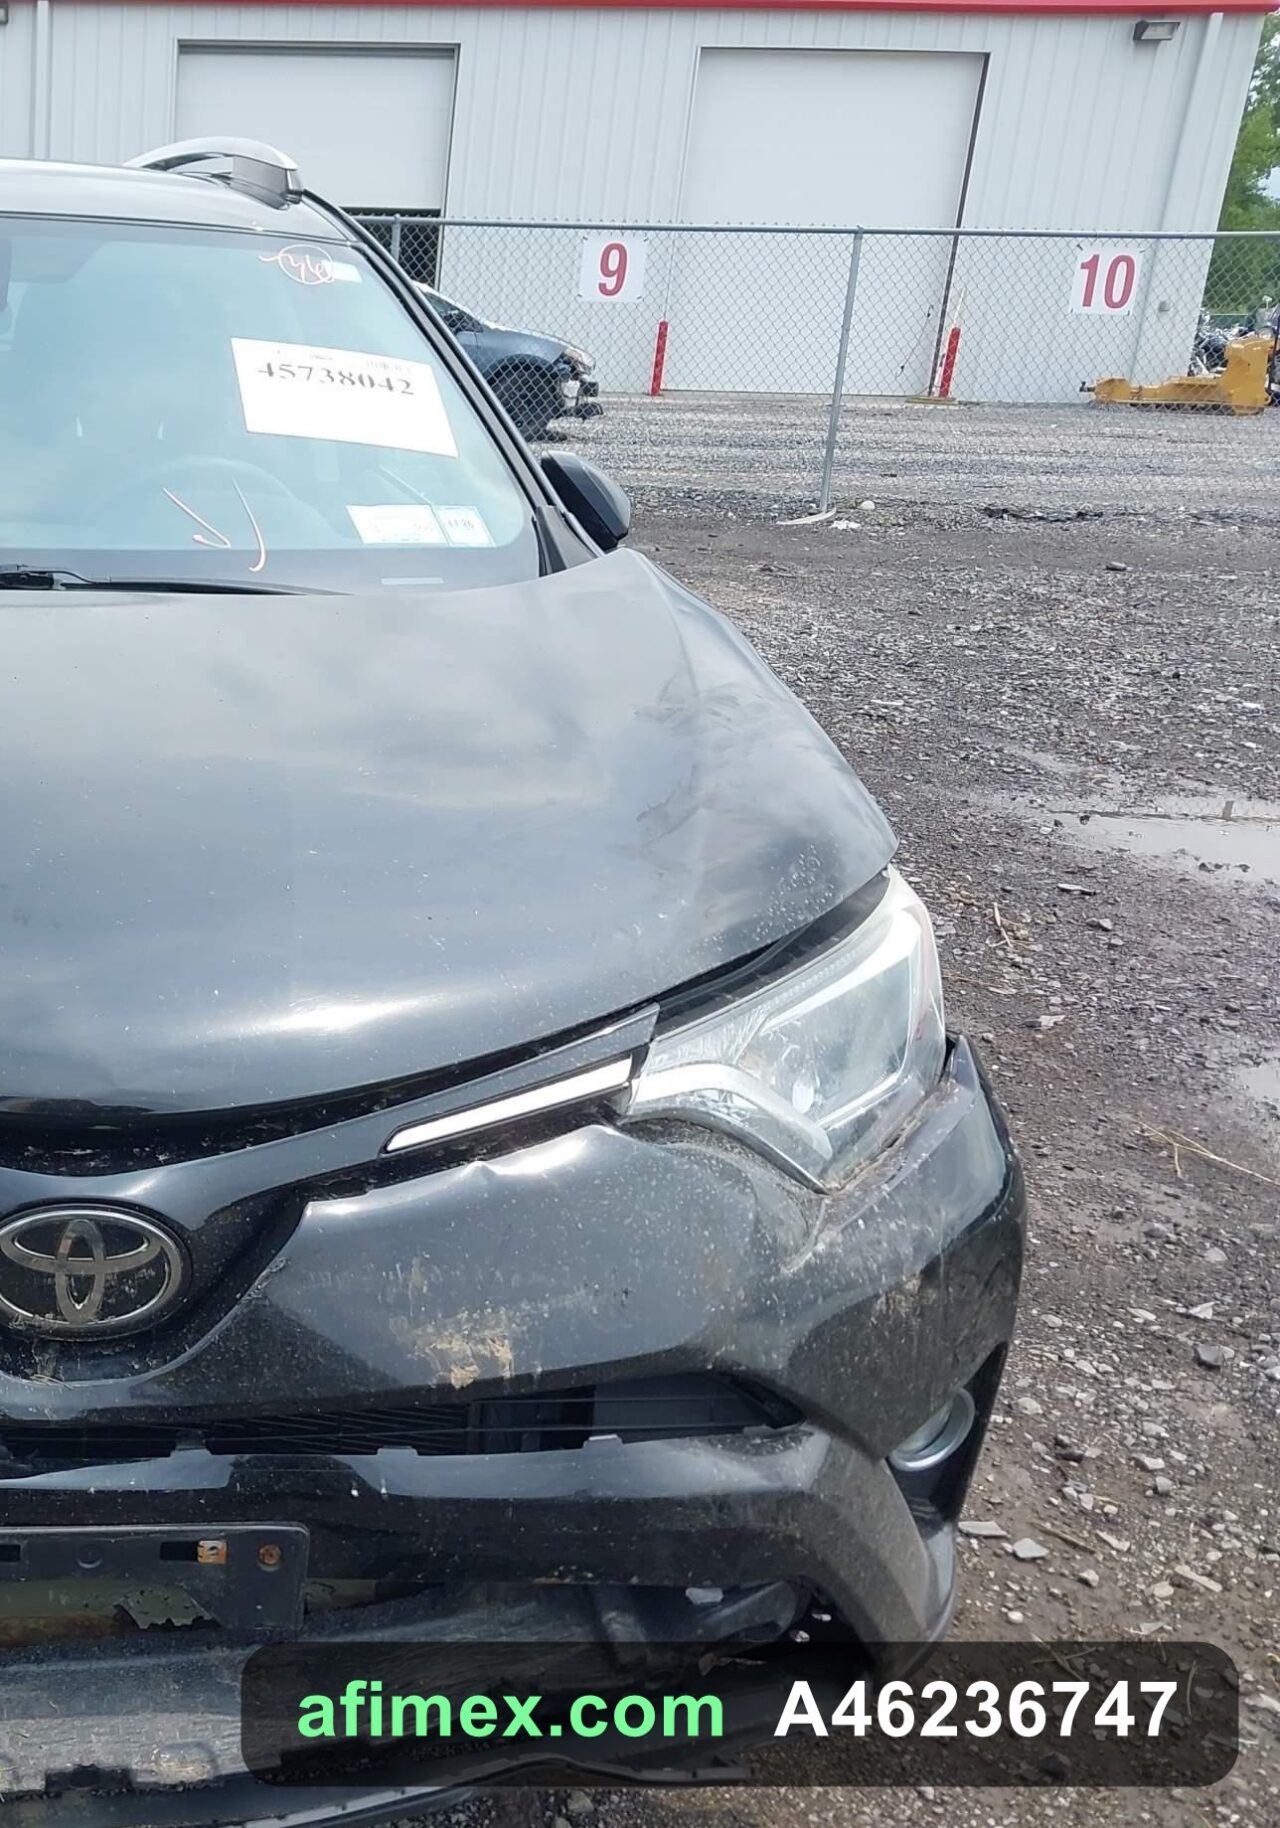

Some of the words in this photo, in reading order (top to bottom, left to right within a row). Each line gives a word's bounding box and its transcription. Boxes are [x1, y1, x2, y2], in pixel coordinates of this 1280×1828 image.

[597, 242, 628, 297] 9
[1079, 253, 1136, 310] 10
[257, 361, 415, 396] 45738042
